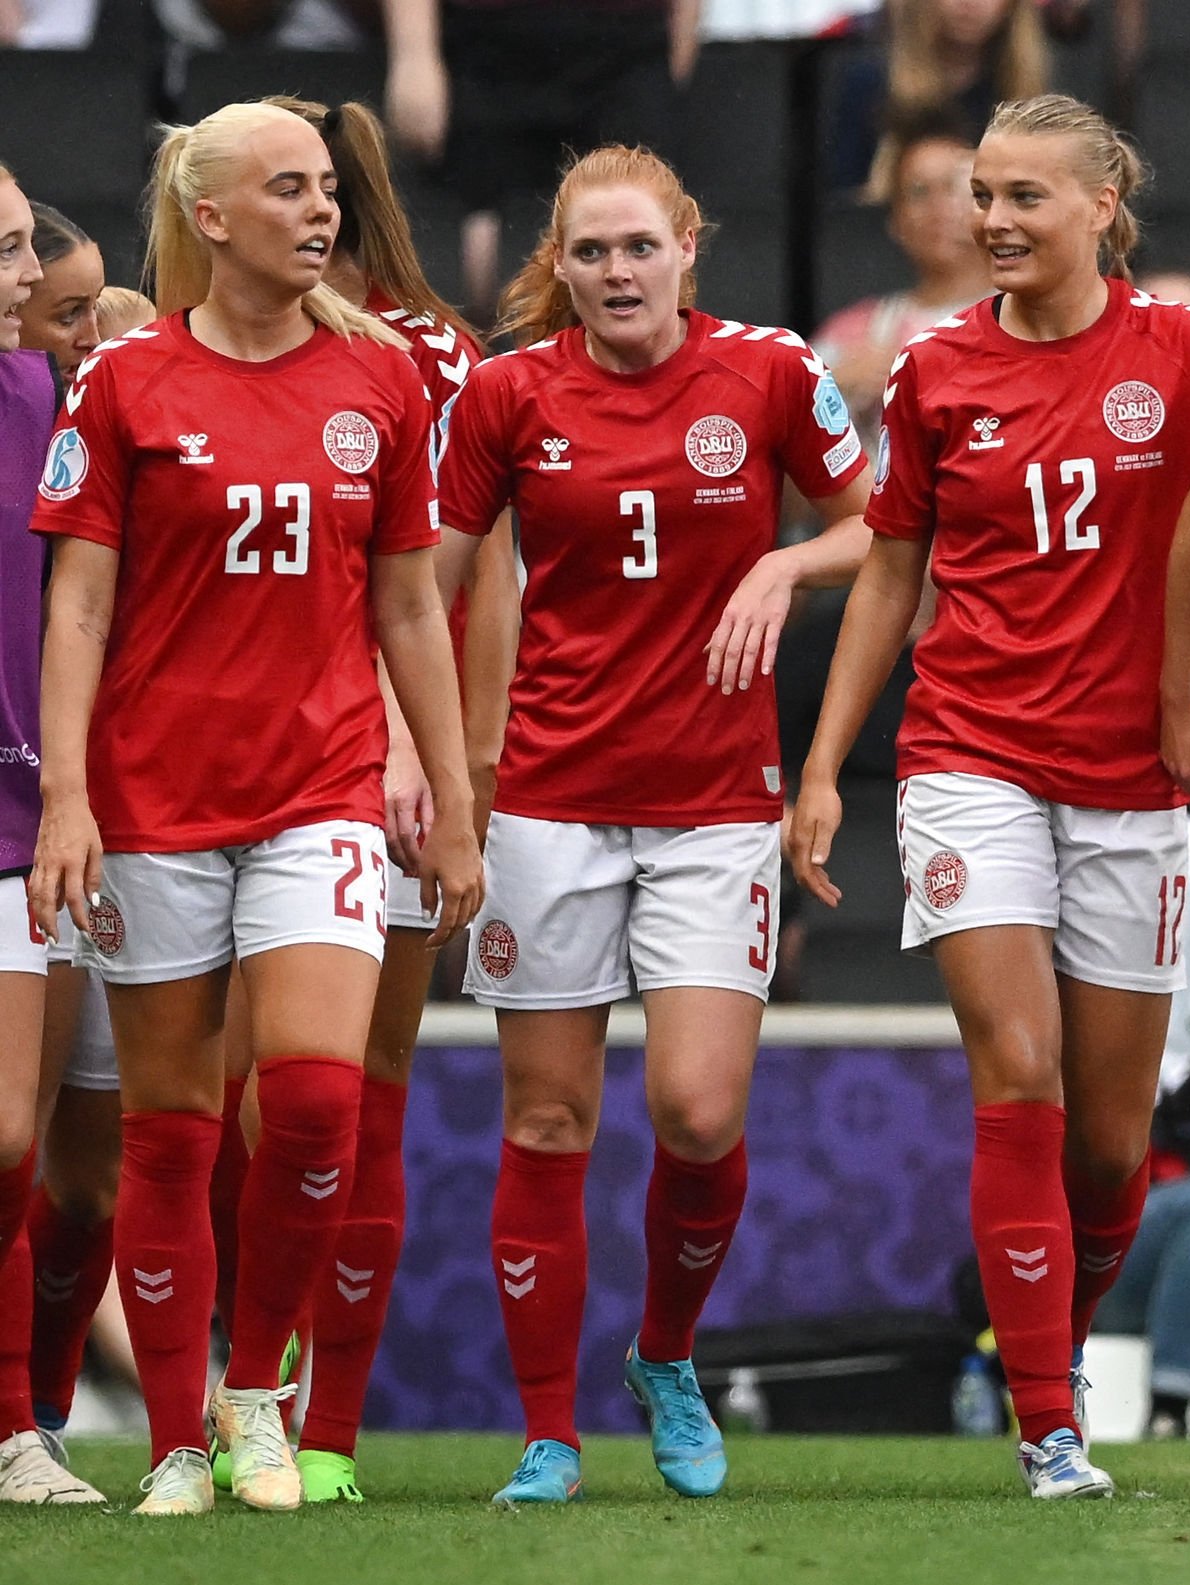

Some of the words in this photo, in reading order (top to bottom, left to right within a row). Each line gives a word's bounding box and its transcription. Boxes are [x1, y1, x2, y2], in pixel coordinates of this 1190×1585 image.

[1117, 402, 1150, 420] DBU
[336, 432, 365, 450] DBU
[699, 436, 733, 454] DBU
[969, 437, 1004, 450] hummel
[179, 454, 214, 464] hummel
[539, 460, 572, 470] hummel
[1024, 457, 1100, 554] 12
[224, 483, 310, 574] 23
[619, 490, 658, 579] 3
[331, 838, 387, 938] 23
[931, 867, 956, 893] DBU
[94, 916, 115, 934] DBU
[748, 882, 770, 973] 3
[1154, 874, 1185, 967] 12
[486, 939, 509, 958] DBU
